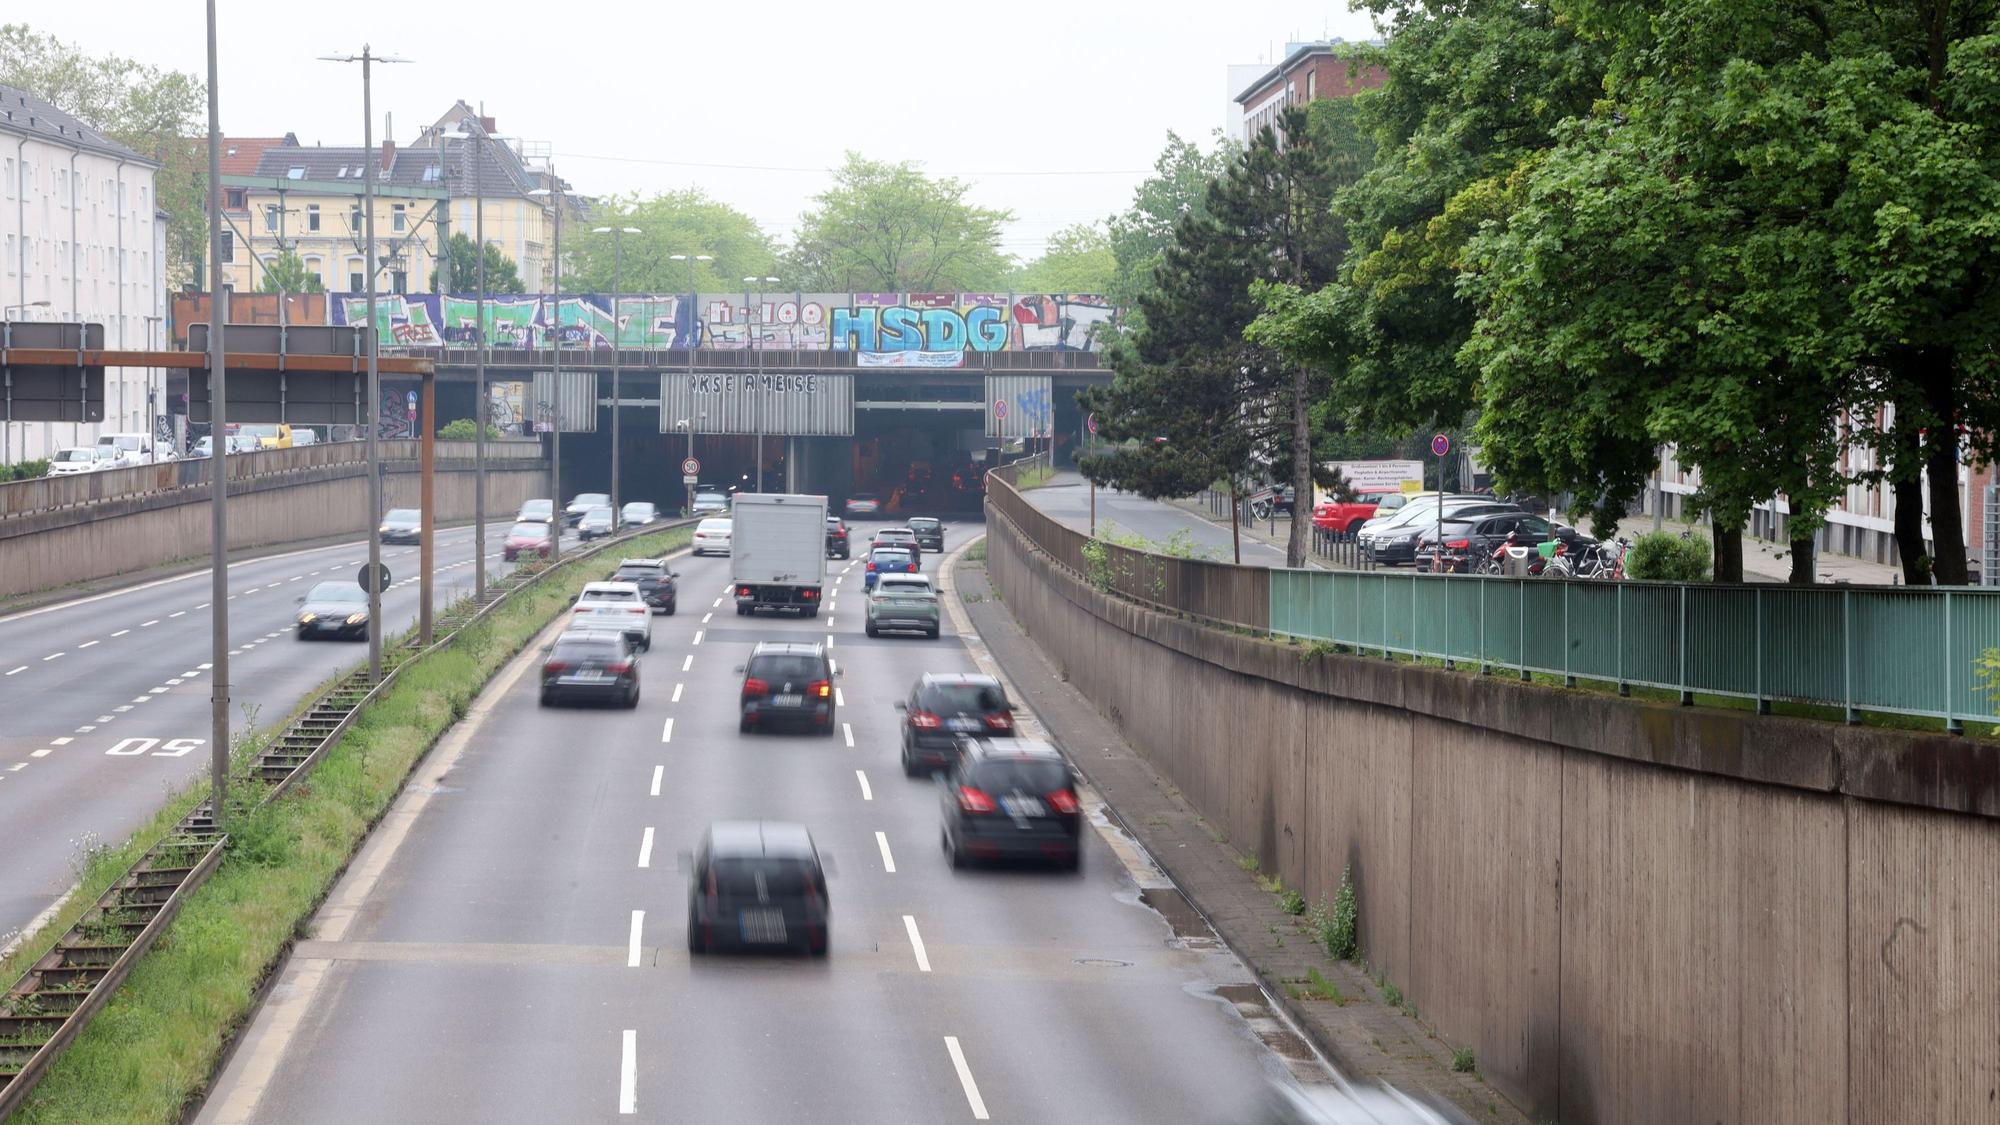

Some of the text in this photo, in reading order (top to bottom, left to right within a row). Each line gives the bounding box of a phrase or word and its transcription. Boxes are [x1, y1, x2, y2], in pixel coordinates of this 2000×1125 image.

[831, 307, 1008, 351] HSDG
[745, 374, 816, 393] AMEISE
[105, 738, 206, 757] 50
